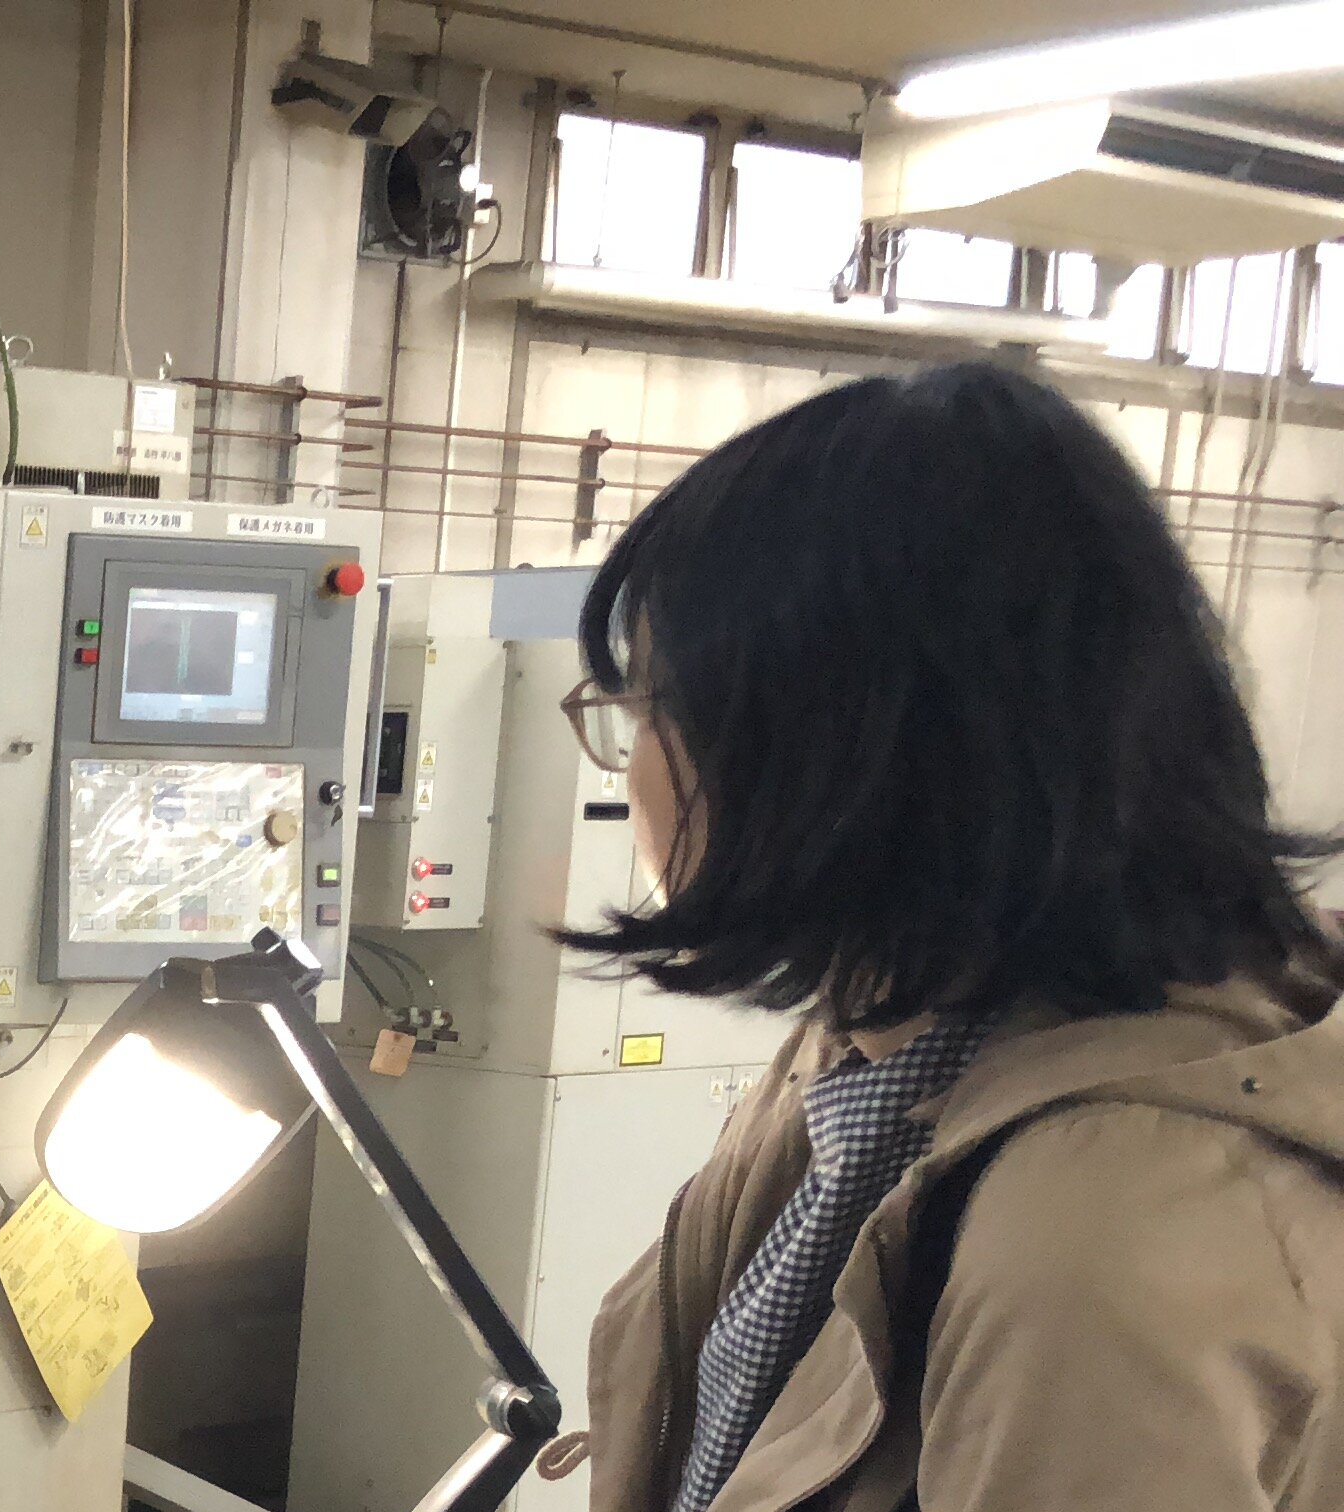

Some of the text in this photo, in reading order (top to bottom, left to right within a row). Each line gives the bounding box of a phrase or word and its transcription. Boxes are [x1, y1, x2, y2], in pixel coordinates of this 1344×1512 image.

[103, 511, 182, 529] 防護マスク着用
[239, 518, 314, 535] 保護メガネ着用
